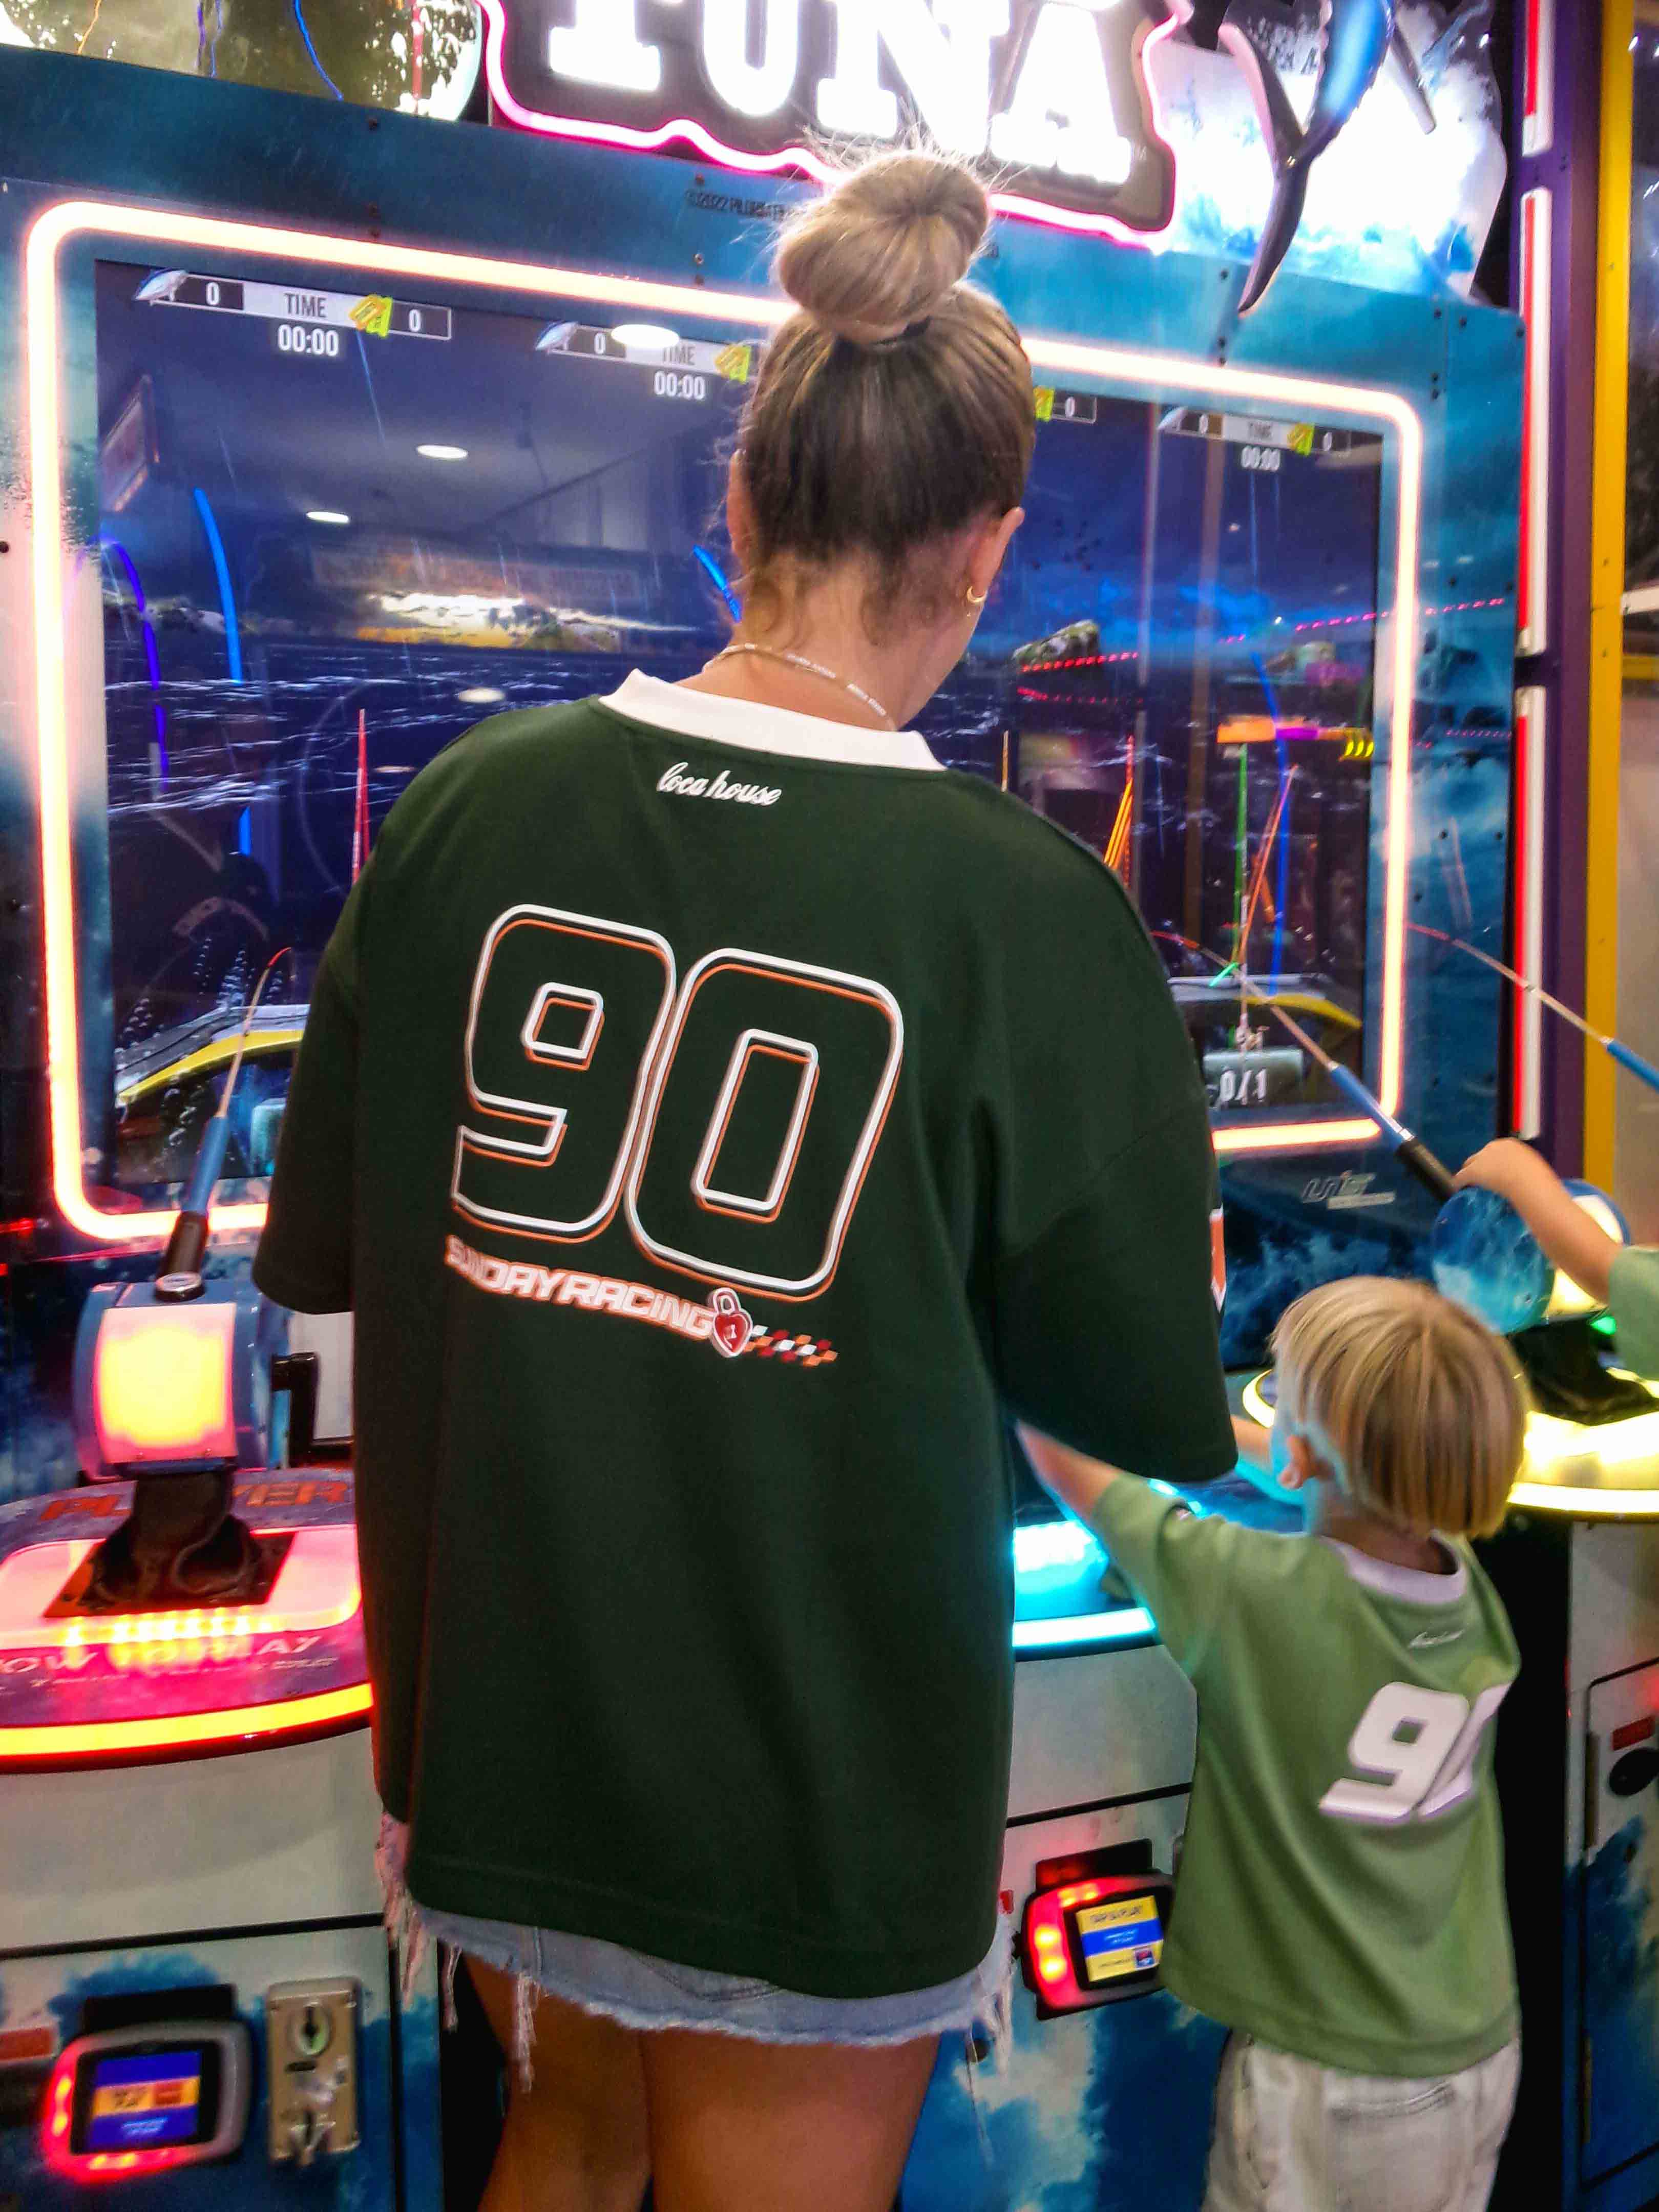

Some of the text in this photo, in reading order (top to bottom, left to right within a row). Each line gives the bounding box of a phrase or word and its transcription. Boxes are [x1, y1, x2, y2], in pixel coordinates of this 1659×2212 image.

[205, 281, 422, 332] 0 TIME 0
[278, 324, 339, 357] 00:00
[594, 332, 606, 354] 0
[654, 370, 706, 401] 00:00
[704, 770, 782, 806] house
[451, 903, 904, 1303] 90
